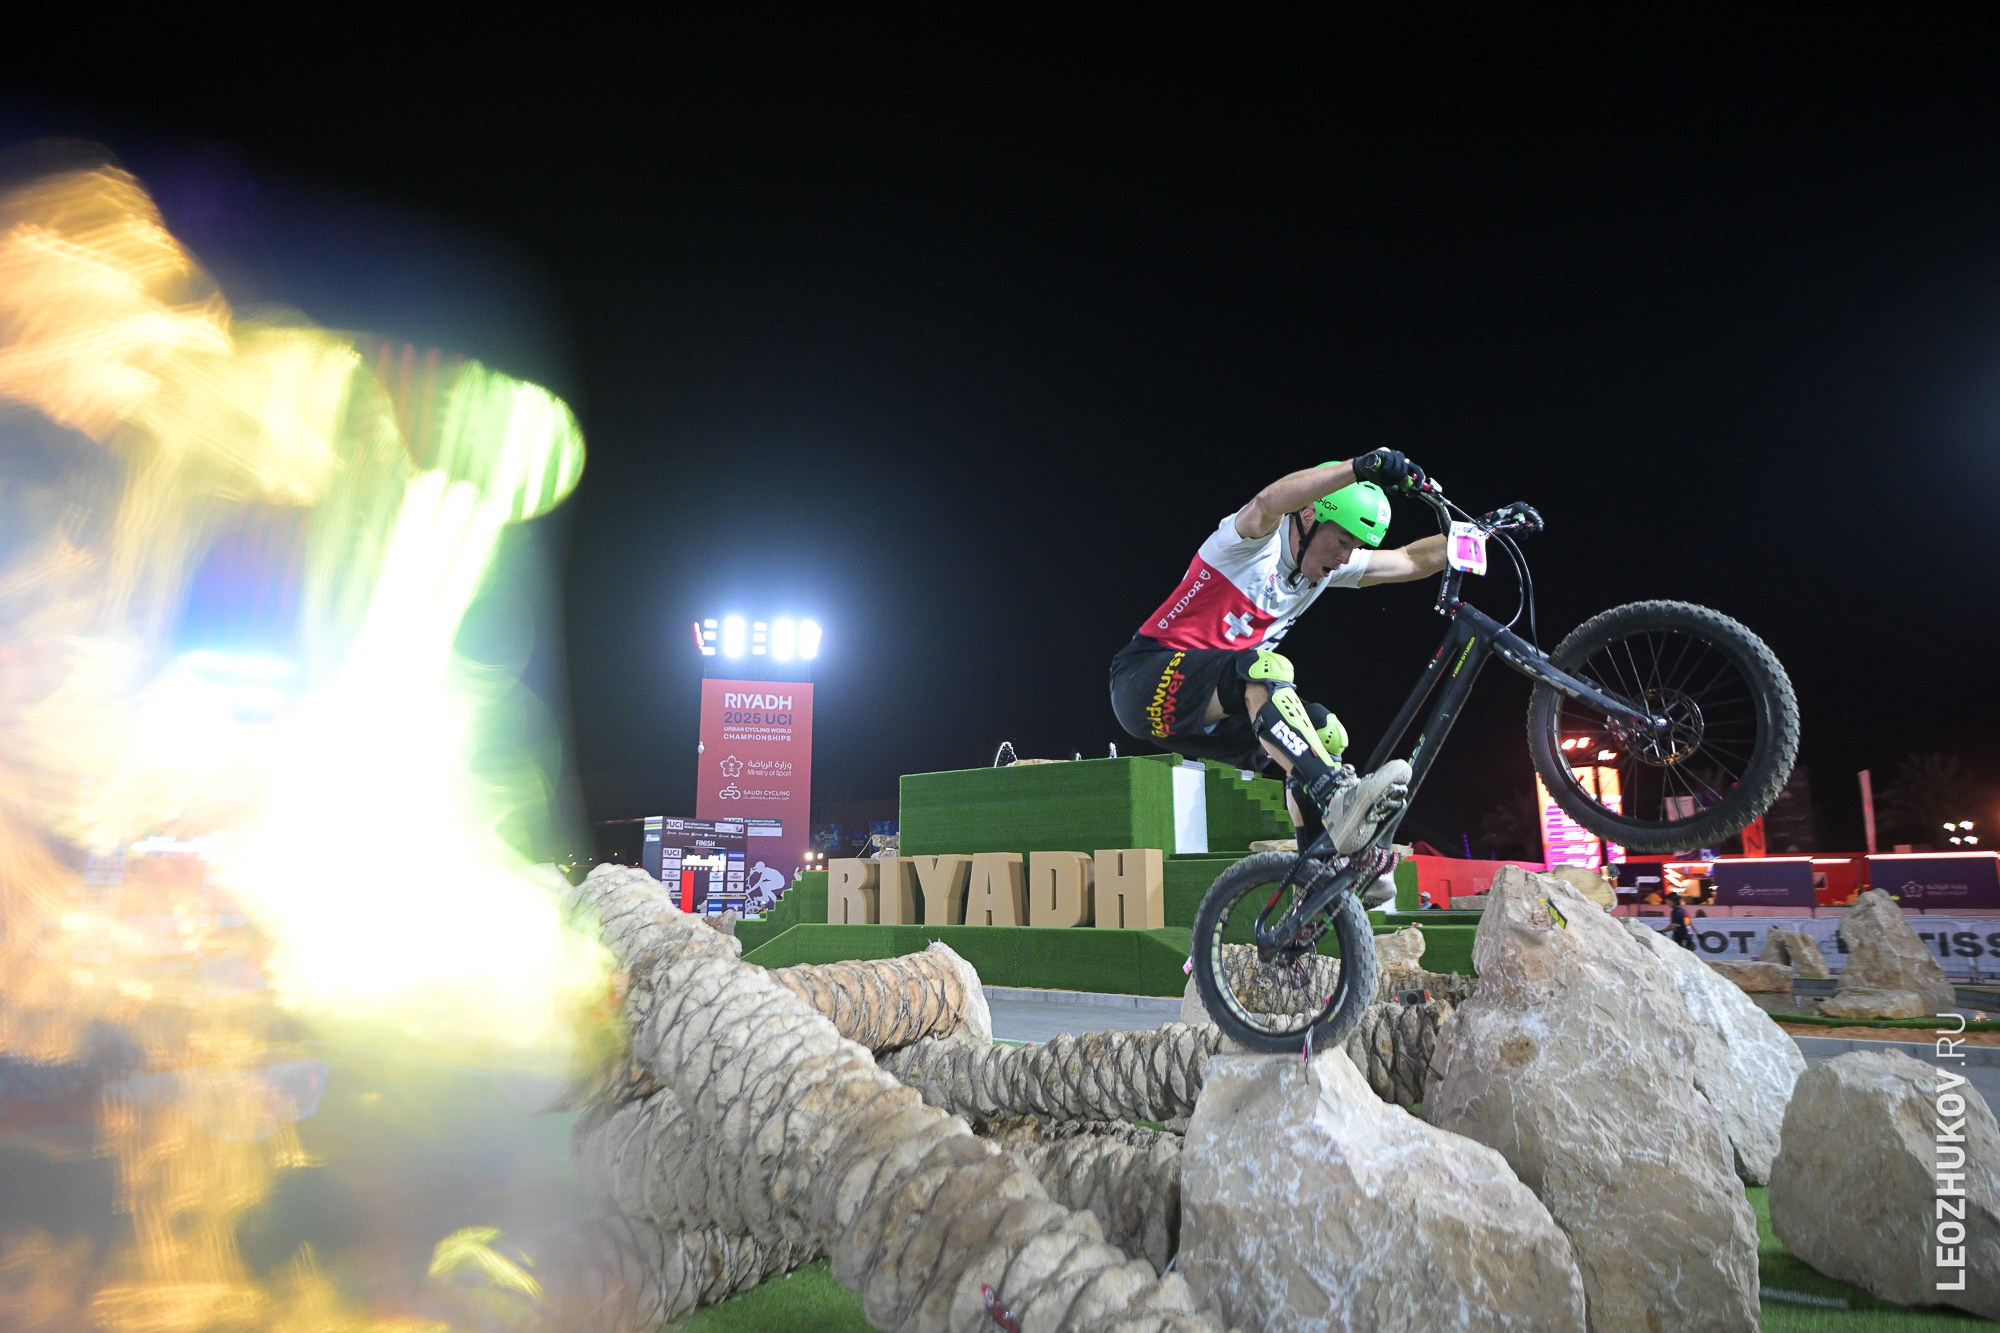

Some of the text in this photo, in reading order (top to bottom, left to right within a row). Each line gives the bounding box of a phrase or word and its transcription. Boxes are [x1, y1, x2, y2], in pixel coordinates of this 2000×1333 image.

[1167, 581, 1205, 620] TUDOR
[724, 692, 793, 710] RIYADH
[1146, 652, 1186, 738] Goldwurst
[1160, 670, 1185, 735] Power
[724, 711, 792, 725] 2025 UCI
[723, 733, 792, 741] CHAMPIONSHIPS
[747, 760, 792, 770] وزارة الرياضة
[669, 820, 682, 828] UCI
[828, 849, 1164, 930] RIYADH
